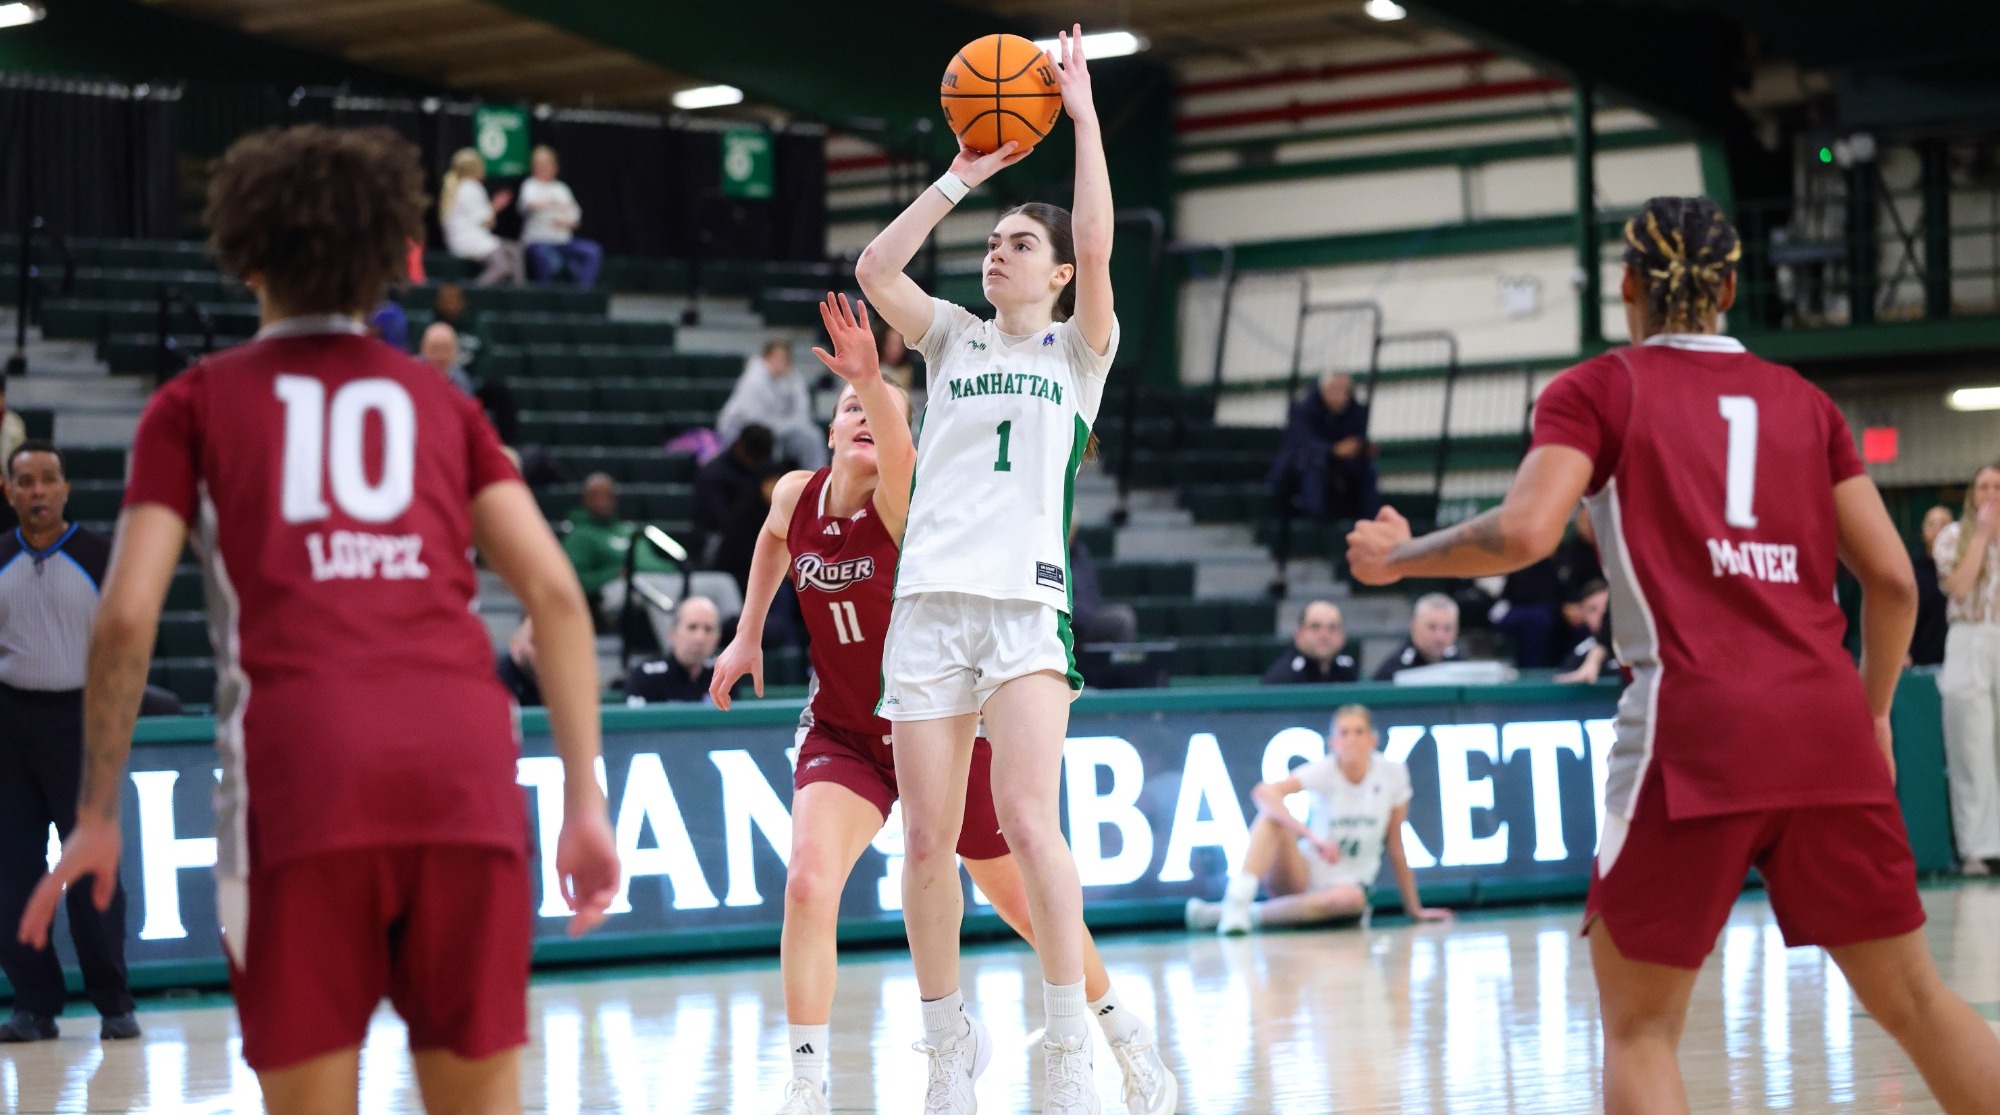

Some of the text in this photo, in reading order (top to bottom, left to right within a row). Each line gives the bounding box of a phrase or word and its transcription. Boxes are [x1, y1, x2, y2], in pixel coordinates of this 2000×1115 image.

[949, 372, 1063, 405] MANHATTAN
[274, 374, 415, 523] 10
[993, 420, 1011, 471] 1
[1718, 395, 1758, 528] 1
[306, 530, 430, 581] LOPEZ
[795, 553, 875, 592] RIDER
[829, 601, 865, 644] 11
